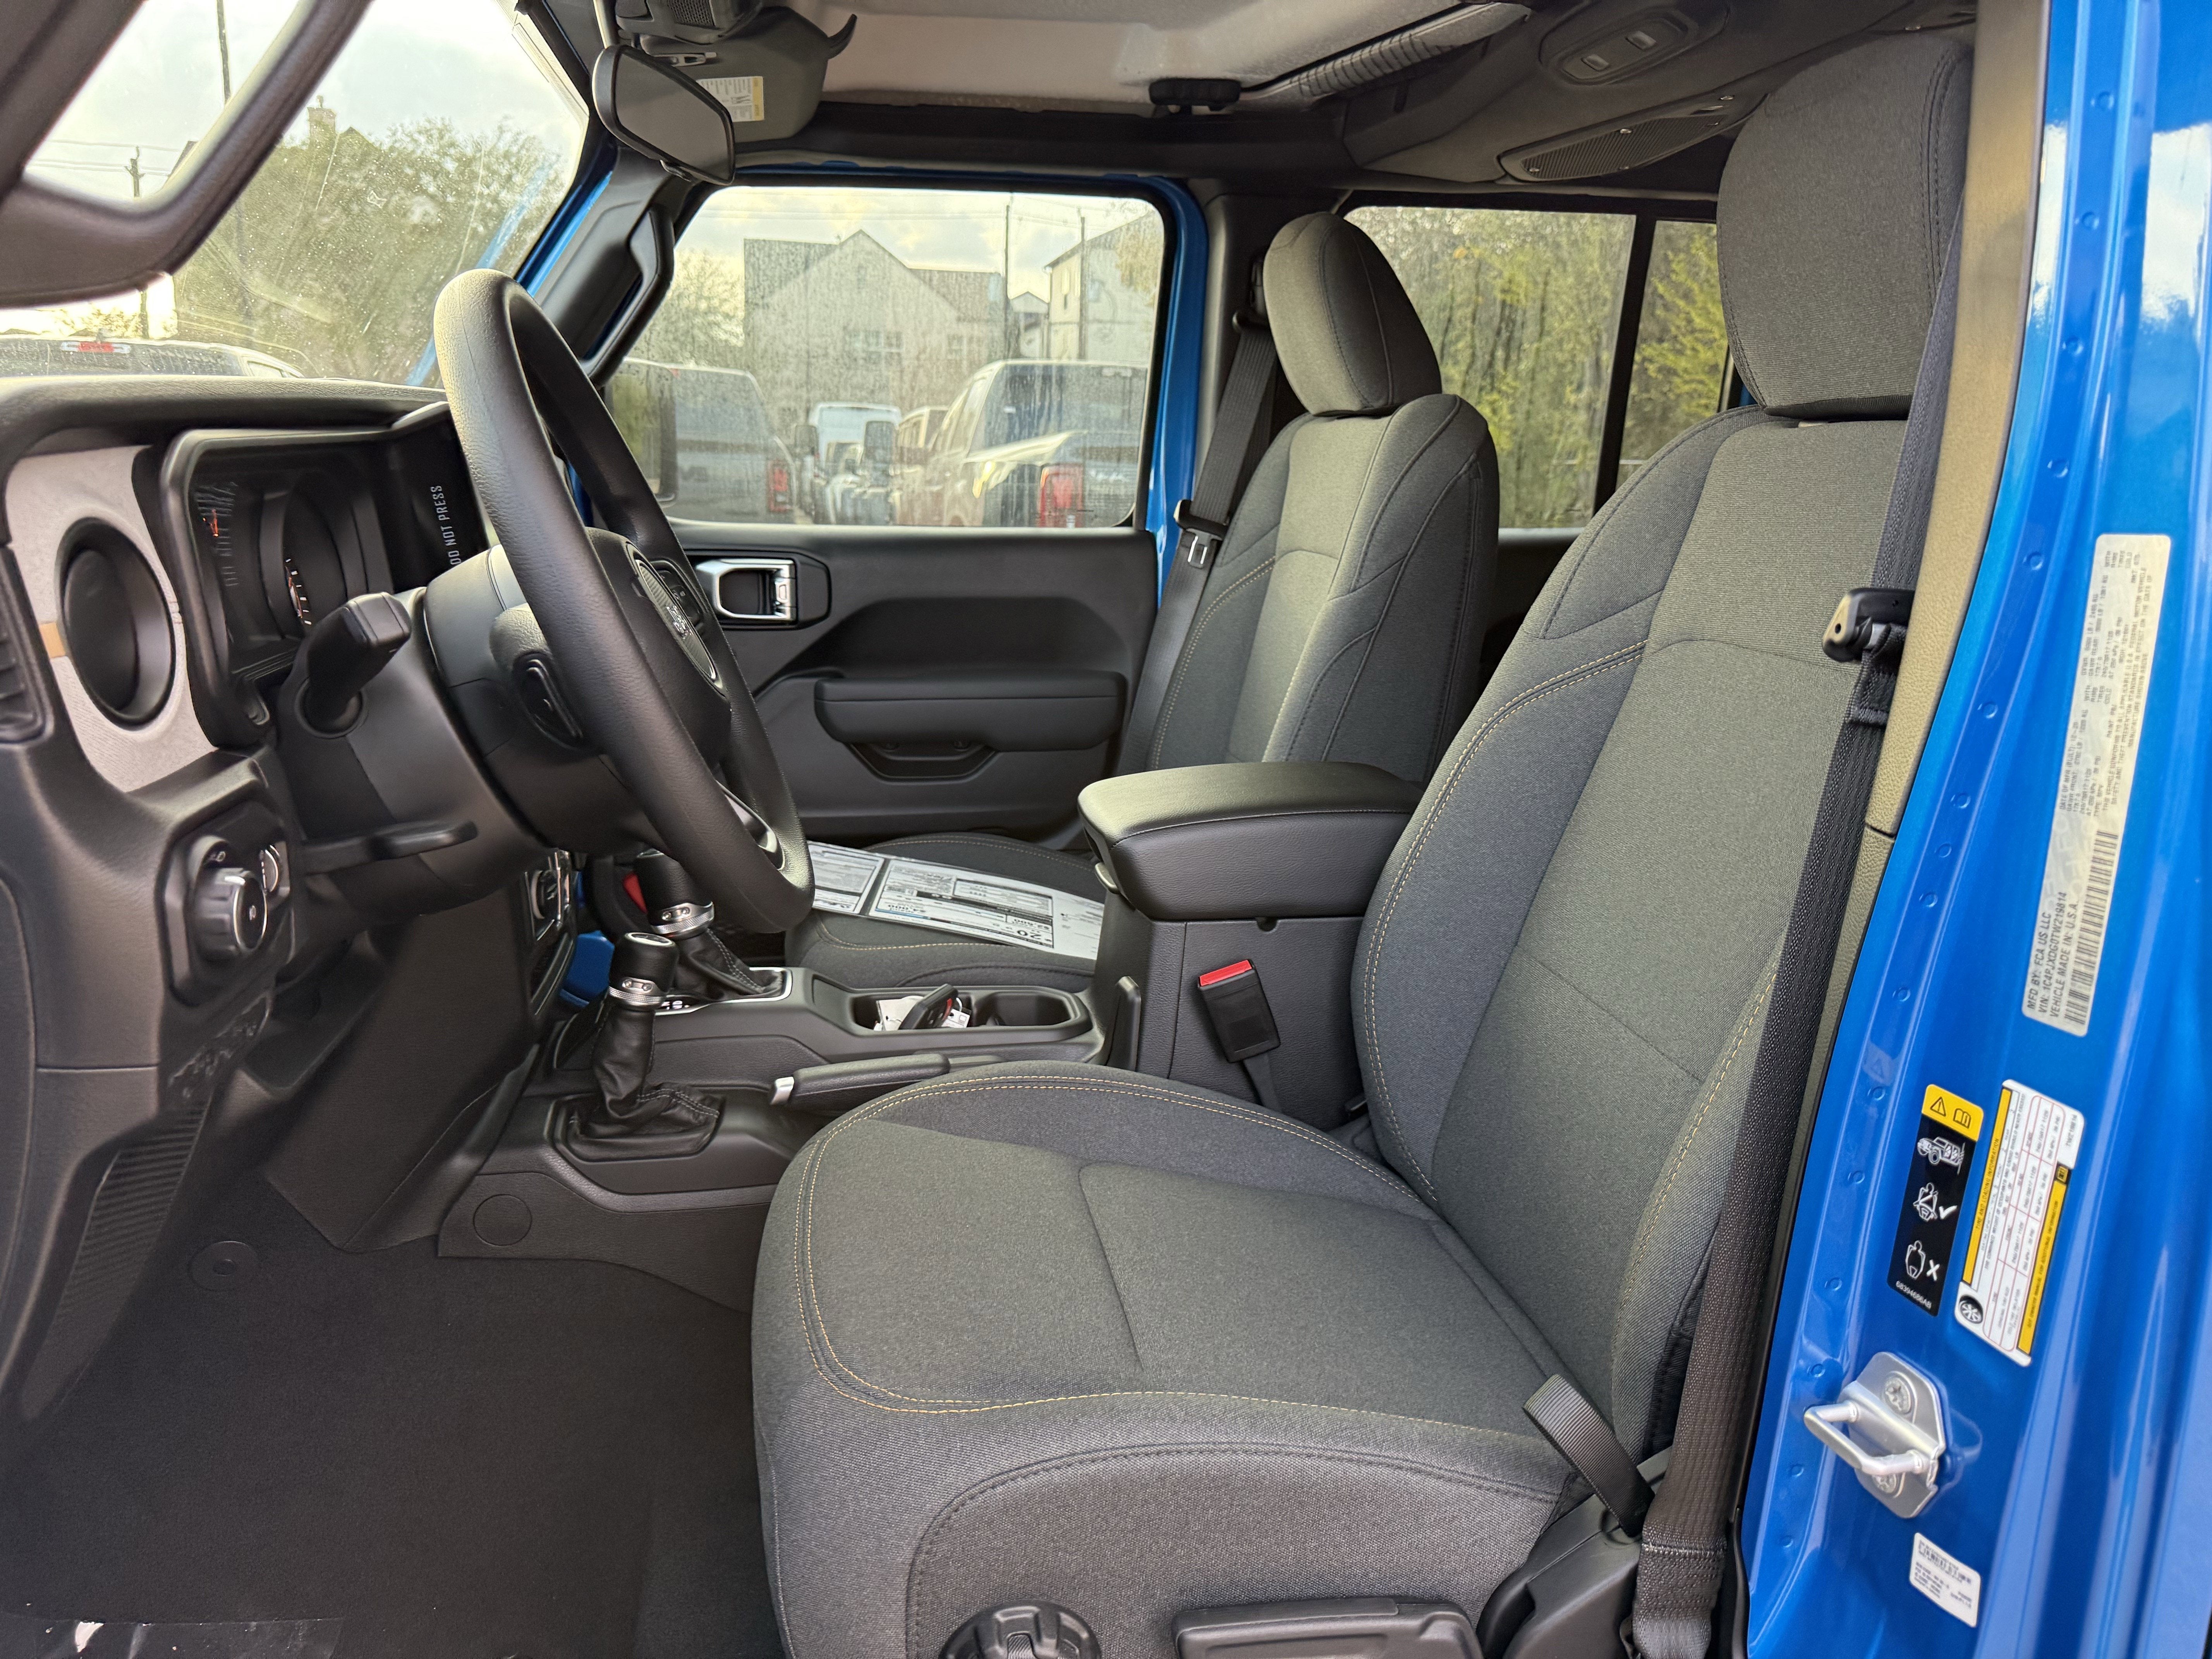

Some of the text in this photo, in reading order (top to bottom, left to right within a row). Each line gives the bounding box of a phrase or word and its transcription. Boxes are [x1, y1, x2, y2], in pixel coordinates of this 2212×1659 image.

[430, 486, 462, 565] DO NOT PRESS
[2040, 912, 2051, 929] LLC
[2037, 931, 2048, 945] US
[2034, 948, 2045, 966] FCA
[2056, 948, 2070, 976] MADE
[2027, 988, 2038, 1010] MFD
[2049, 978, 2065, 1018] VEHICLE
[1987, 1137, 1999, 1177] INFORMATION
